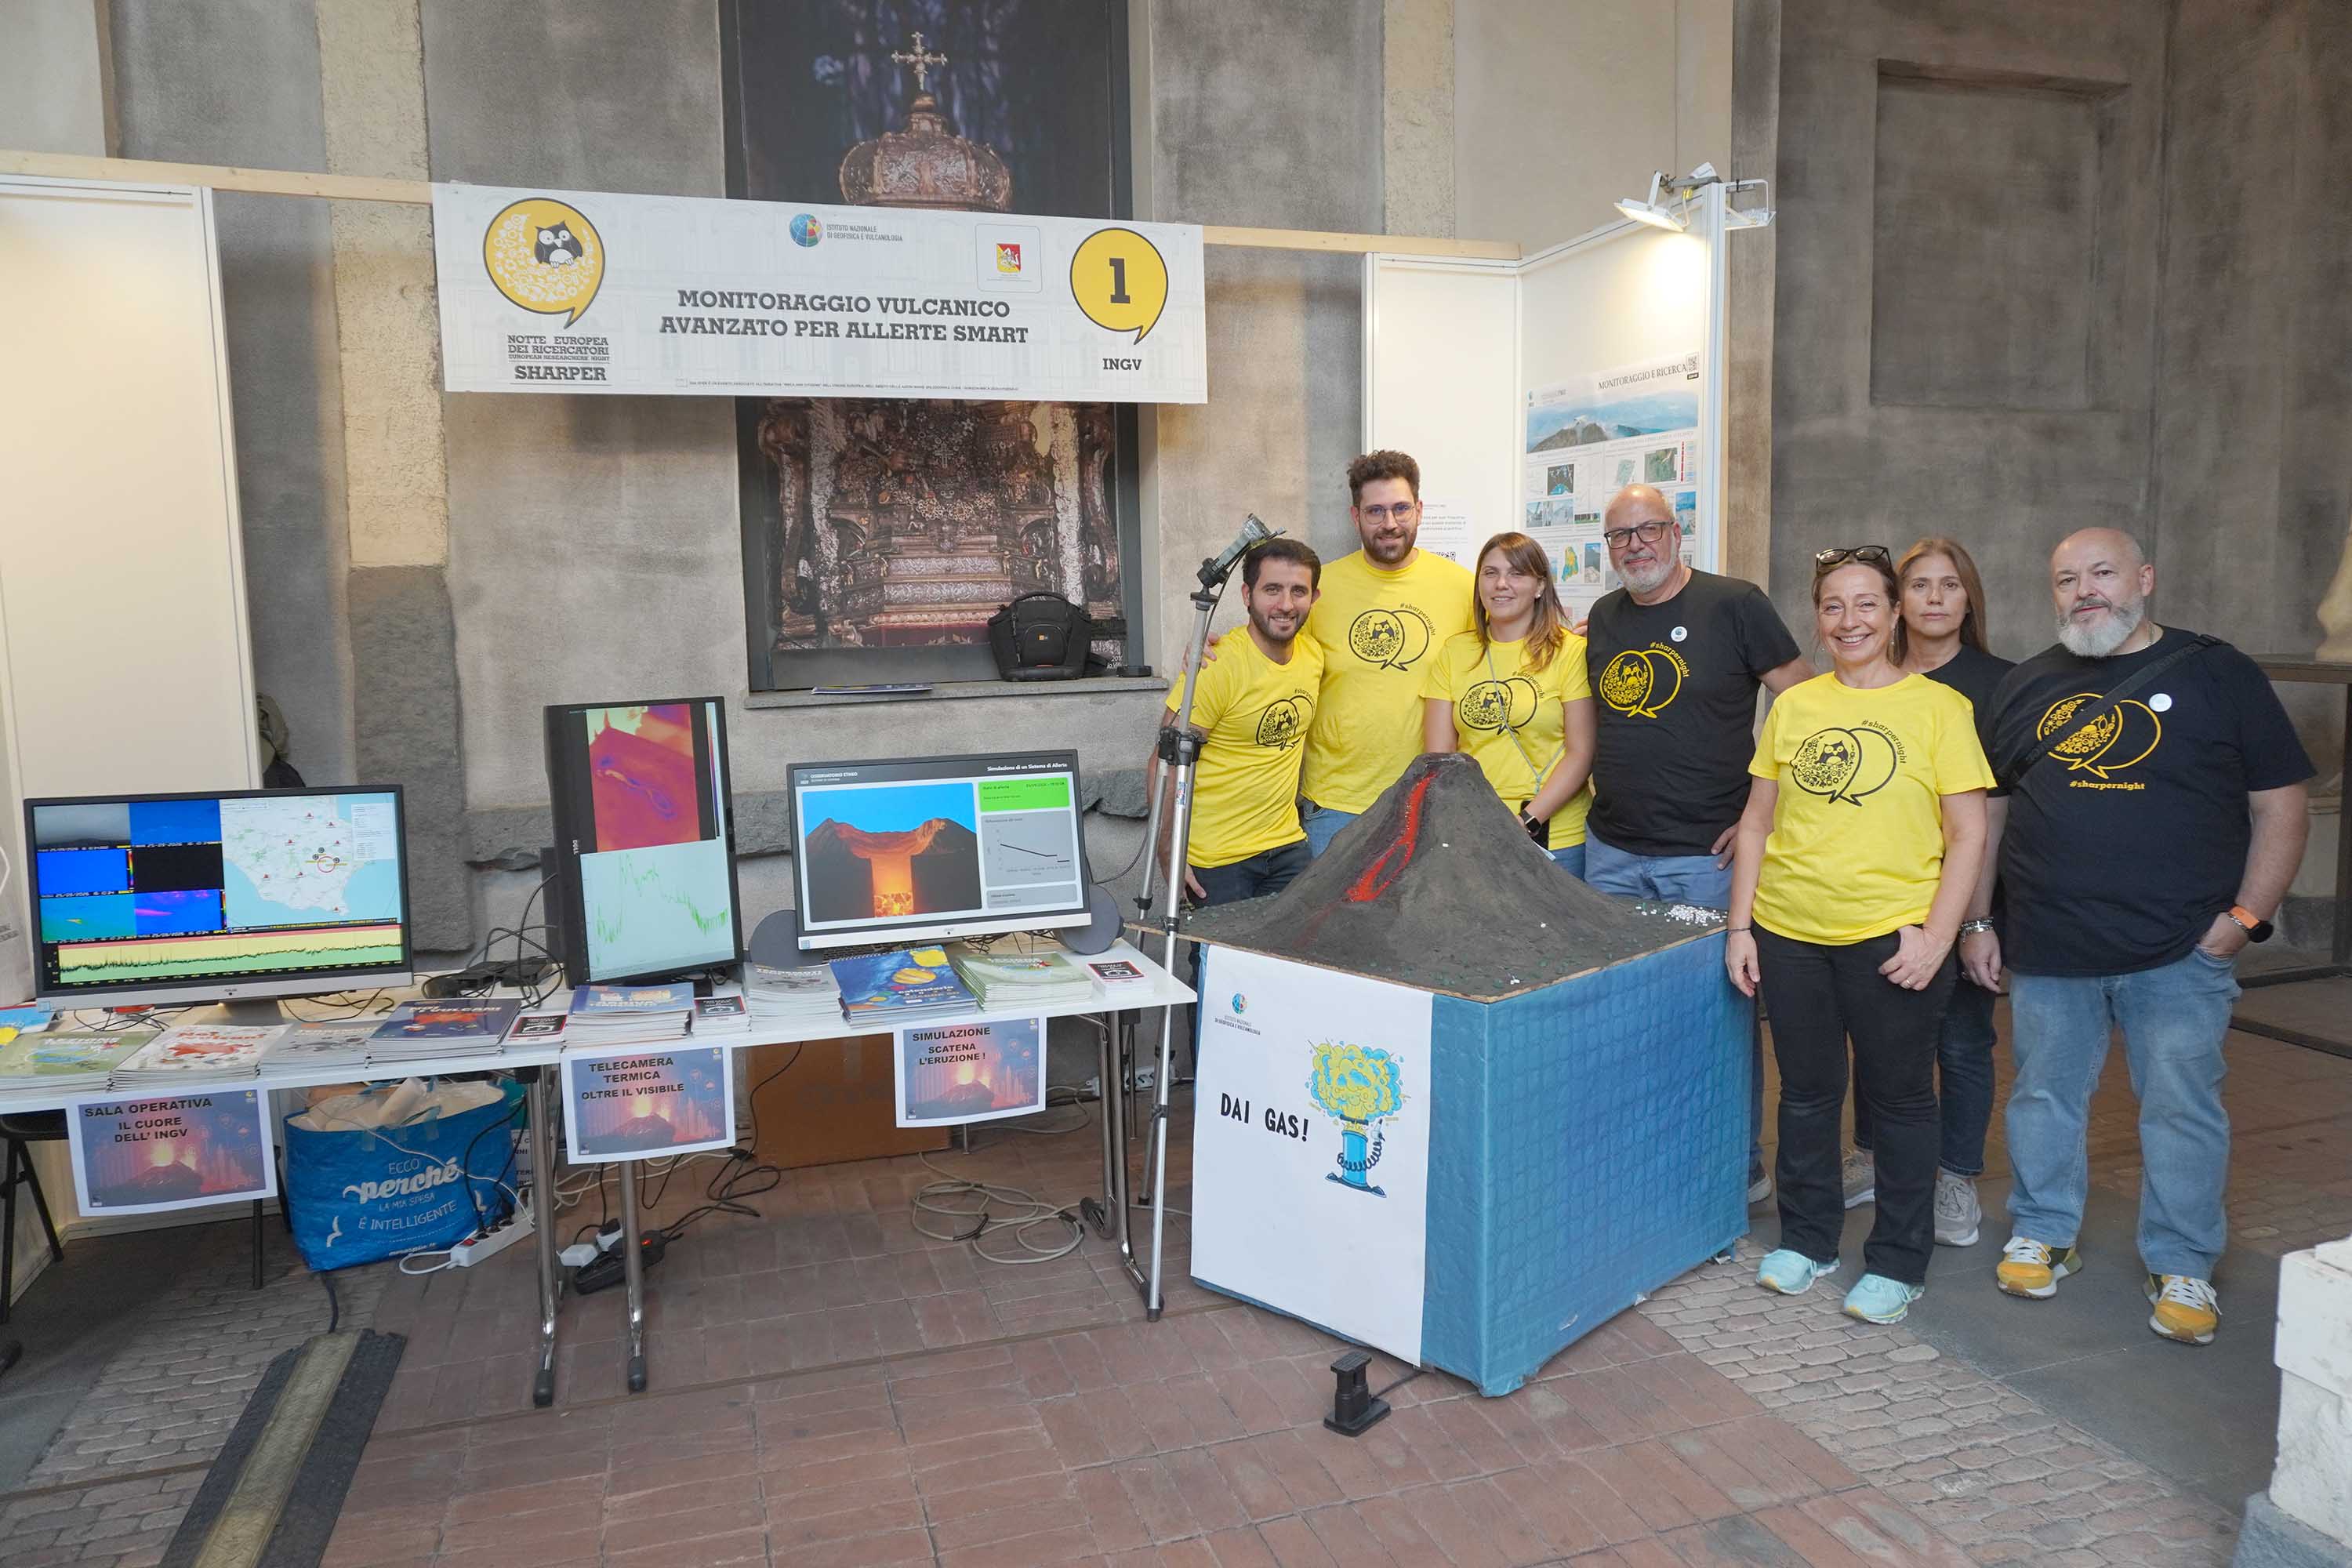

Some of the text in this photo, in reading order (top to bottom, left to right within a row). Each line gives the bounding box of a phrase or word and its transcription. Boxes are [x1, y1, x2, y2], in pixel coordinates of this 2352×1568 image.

[1109, 256, 1131, 304] 1
[677, 289, 1011, 318] MONITORAGGIO VULCANICO
[659, 316, 1029, 343] AVANZATO PER ALLERTE SMART
[507, 335, 609, 346] NOTTE EUROPEA
[532, 346, 609, 355] RICERCATORI
[514, 365, 607, 380] SHARPER
[1102, 358, 1142, 371] INGV
[1598, 363, 1687, 390] MONITORAGGIO E RICERCA
[1650, 641, 1690, 677] #sharpernight
[1861, 719, 1907, 764] #sharpernight
[2070, 780, 2146, 791] #sharpernight
[913, 1027, 991, 1041] SIMULAZIONE
[928, 1043, 976, 1054] SCATENA
[589, 1057, 674, 1073] TELECAMERA
[919, 1053, 980, 1065] L'ERUZIONE
[603, 1071, 660, 1083] TERMICA
[582, 1089, 619, 1100] OLTRE
[636, 1083, 684, 1095] VISIBILE
[85, 1098, 212, 1117] SALA OPERATIVA
[118, 1116, 182, 1131] IL CUORE
[1221, 1093, 1309, 1142] DAI GAS!
[114, 1128, 188, 1143] DELL' INGV
[388, 1158, 420, 1174] ECCO
[343, 1156, 459, 1204] perché
[379, 1192, 435, 1212] LA MIA SPESA
[370, 1200, 458, 1230] INTELLIGENTE
